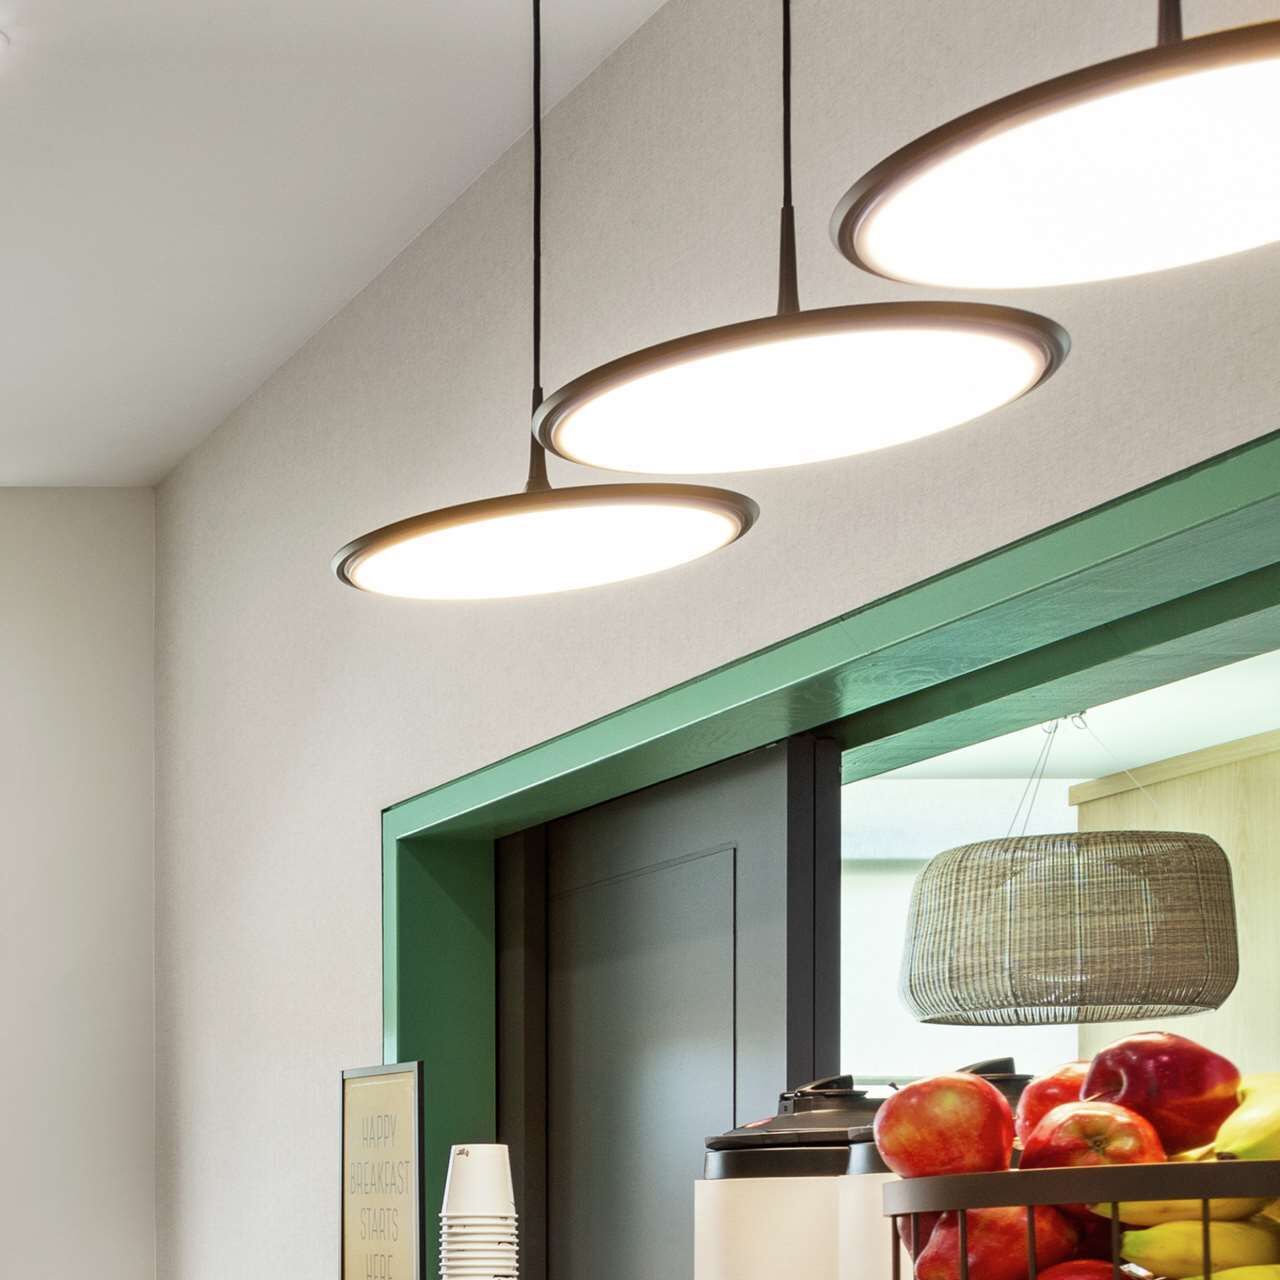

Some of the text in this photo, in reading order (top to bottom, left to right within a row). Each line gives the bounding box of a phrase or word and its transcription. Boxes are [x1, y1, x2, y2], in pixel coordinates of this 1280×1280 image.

[361, 1113, 397, 1147] HAPPY
[349, 1160, 411, 1196] BREAKFAST
[360, 1206, 400, 1243] STARTS
